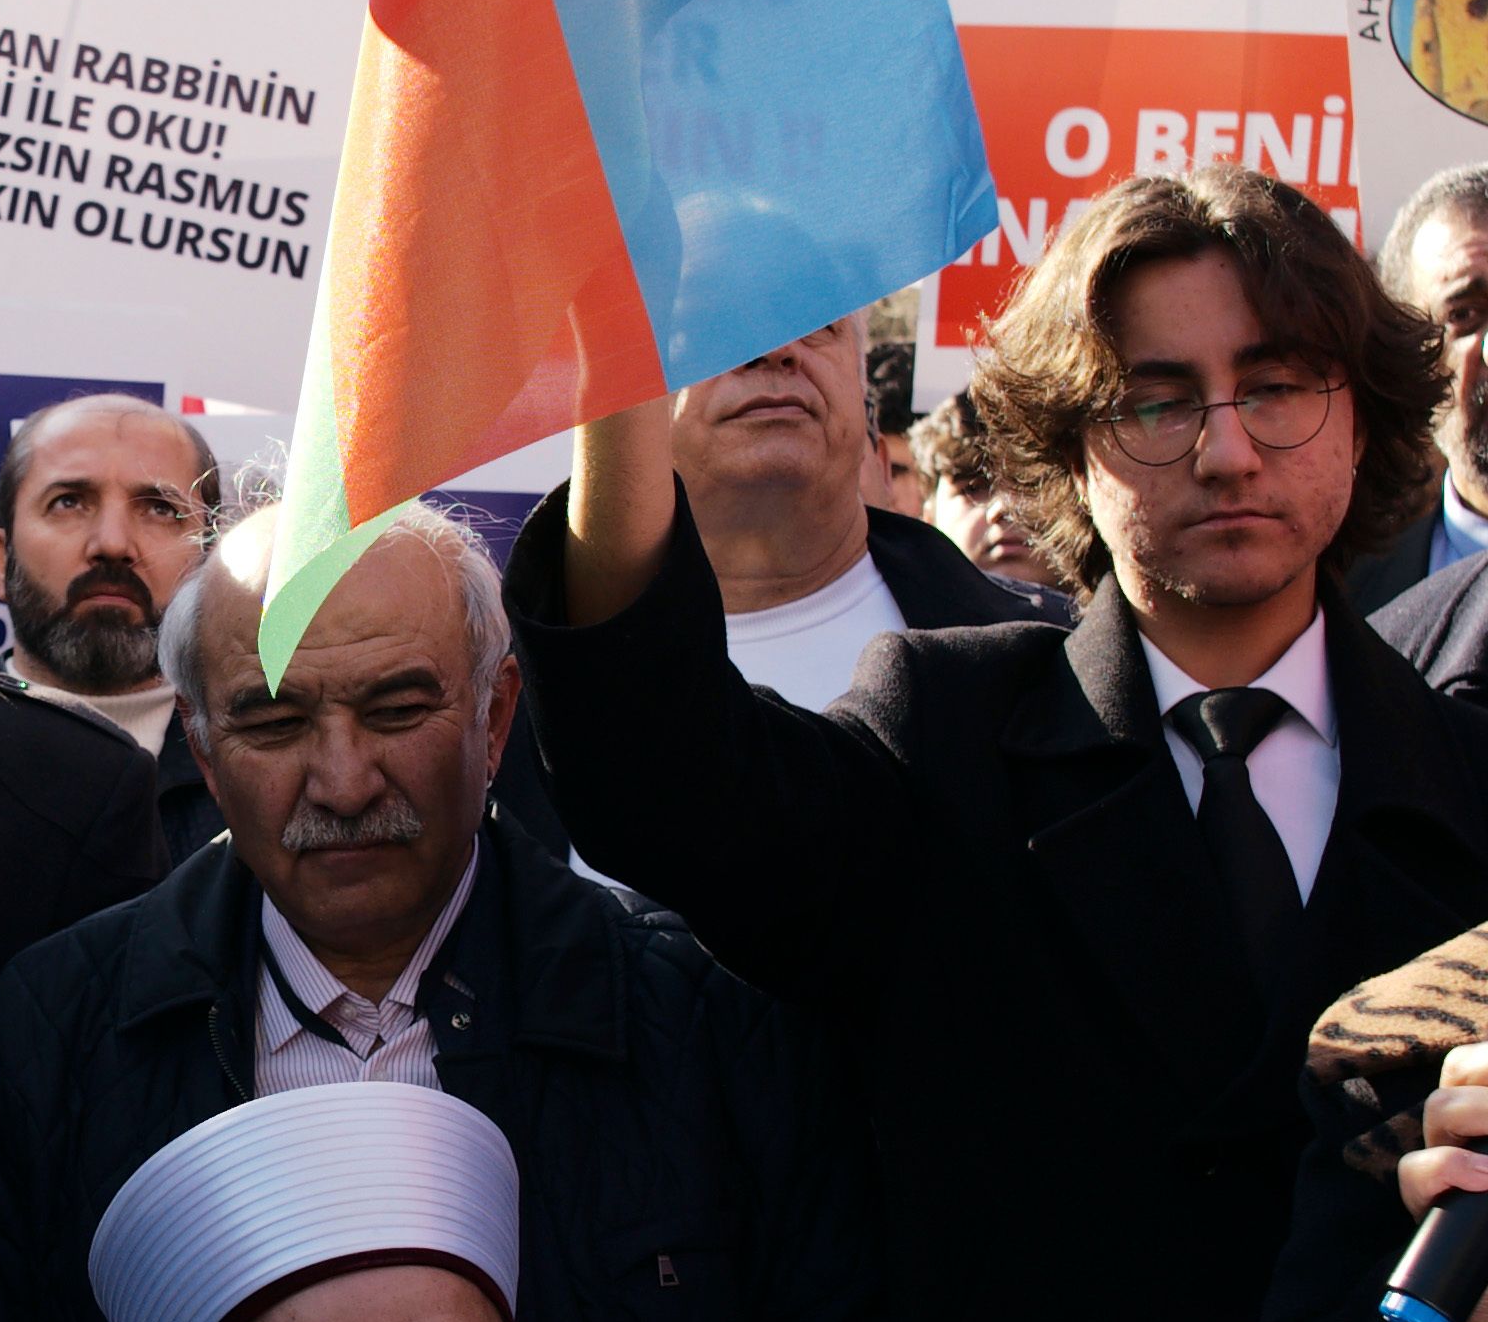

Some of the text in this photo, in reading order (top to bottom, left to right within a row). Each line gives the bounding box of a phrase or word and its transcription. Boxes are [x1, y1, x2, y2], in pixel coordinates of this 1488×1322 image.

[25, 75, 95, 133] İLE
[106, 103, 228, 160] OKU!
[72, 42, 318, 126] RABBİNİN
[1044, 94, 1360, 187] O BENİ
[103, 152, 310, 228] RASMUS
[72, 201, 312, 280] OLURSUN
